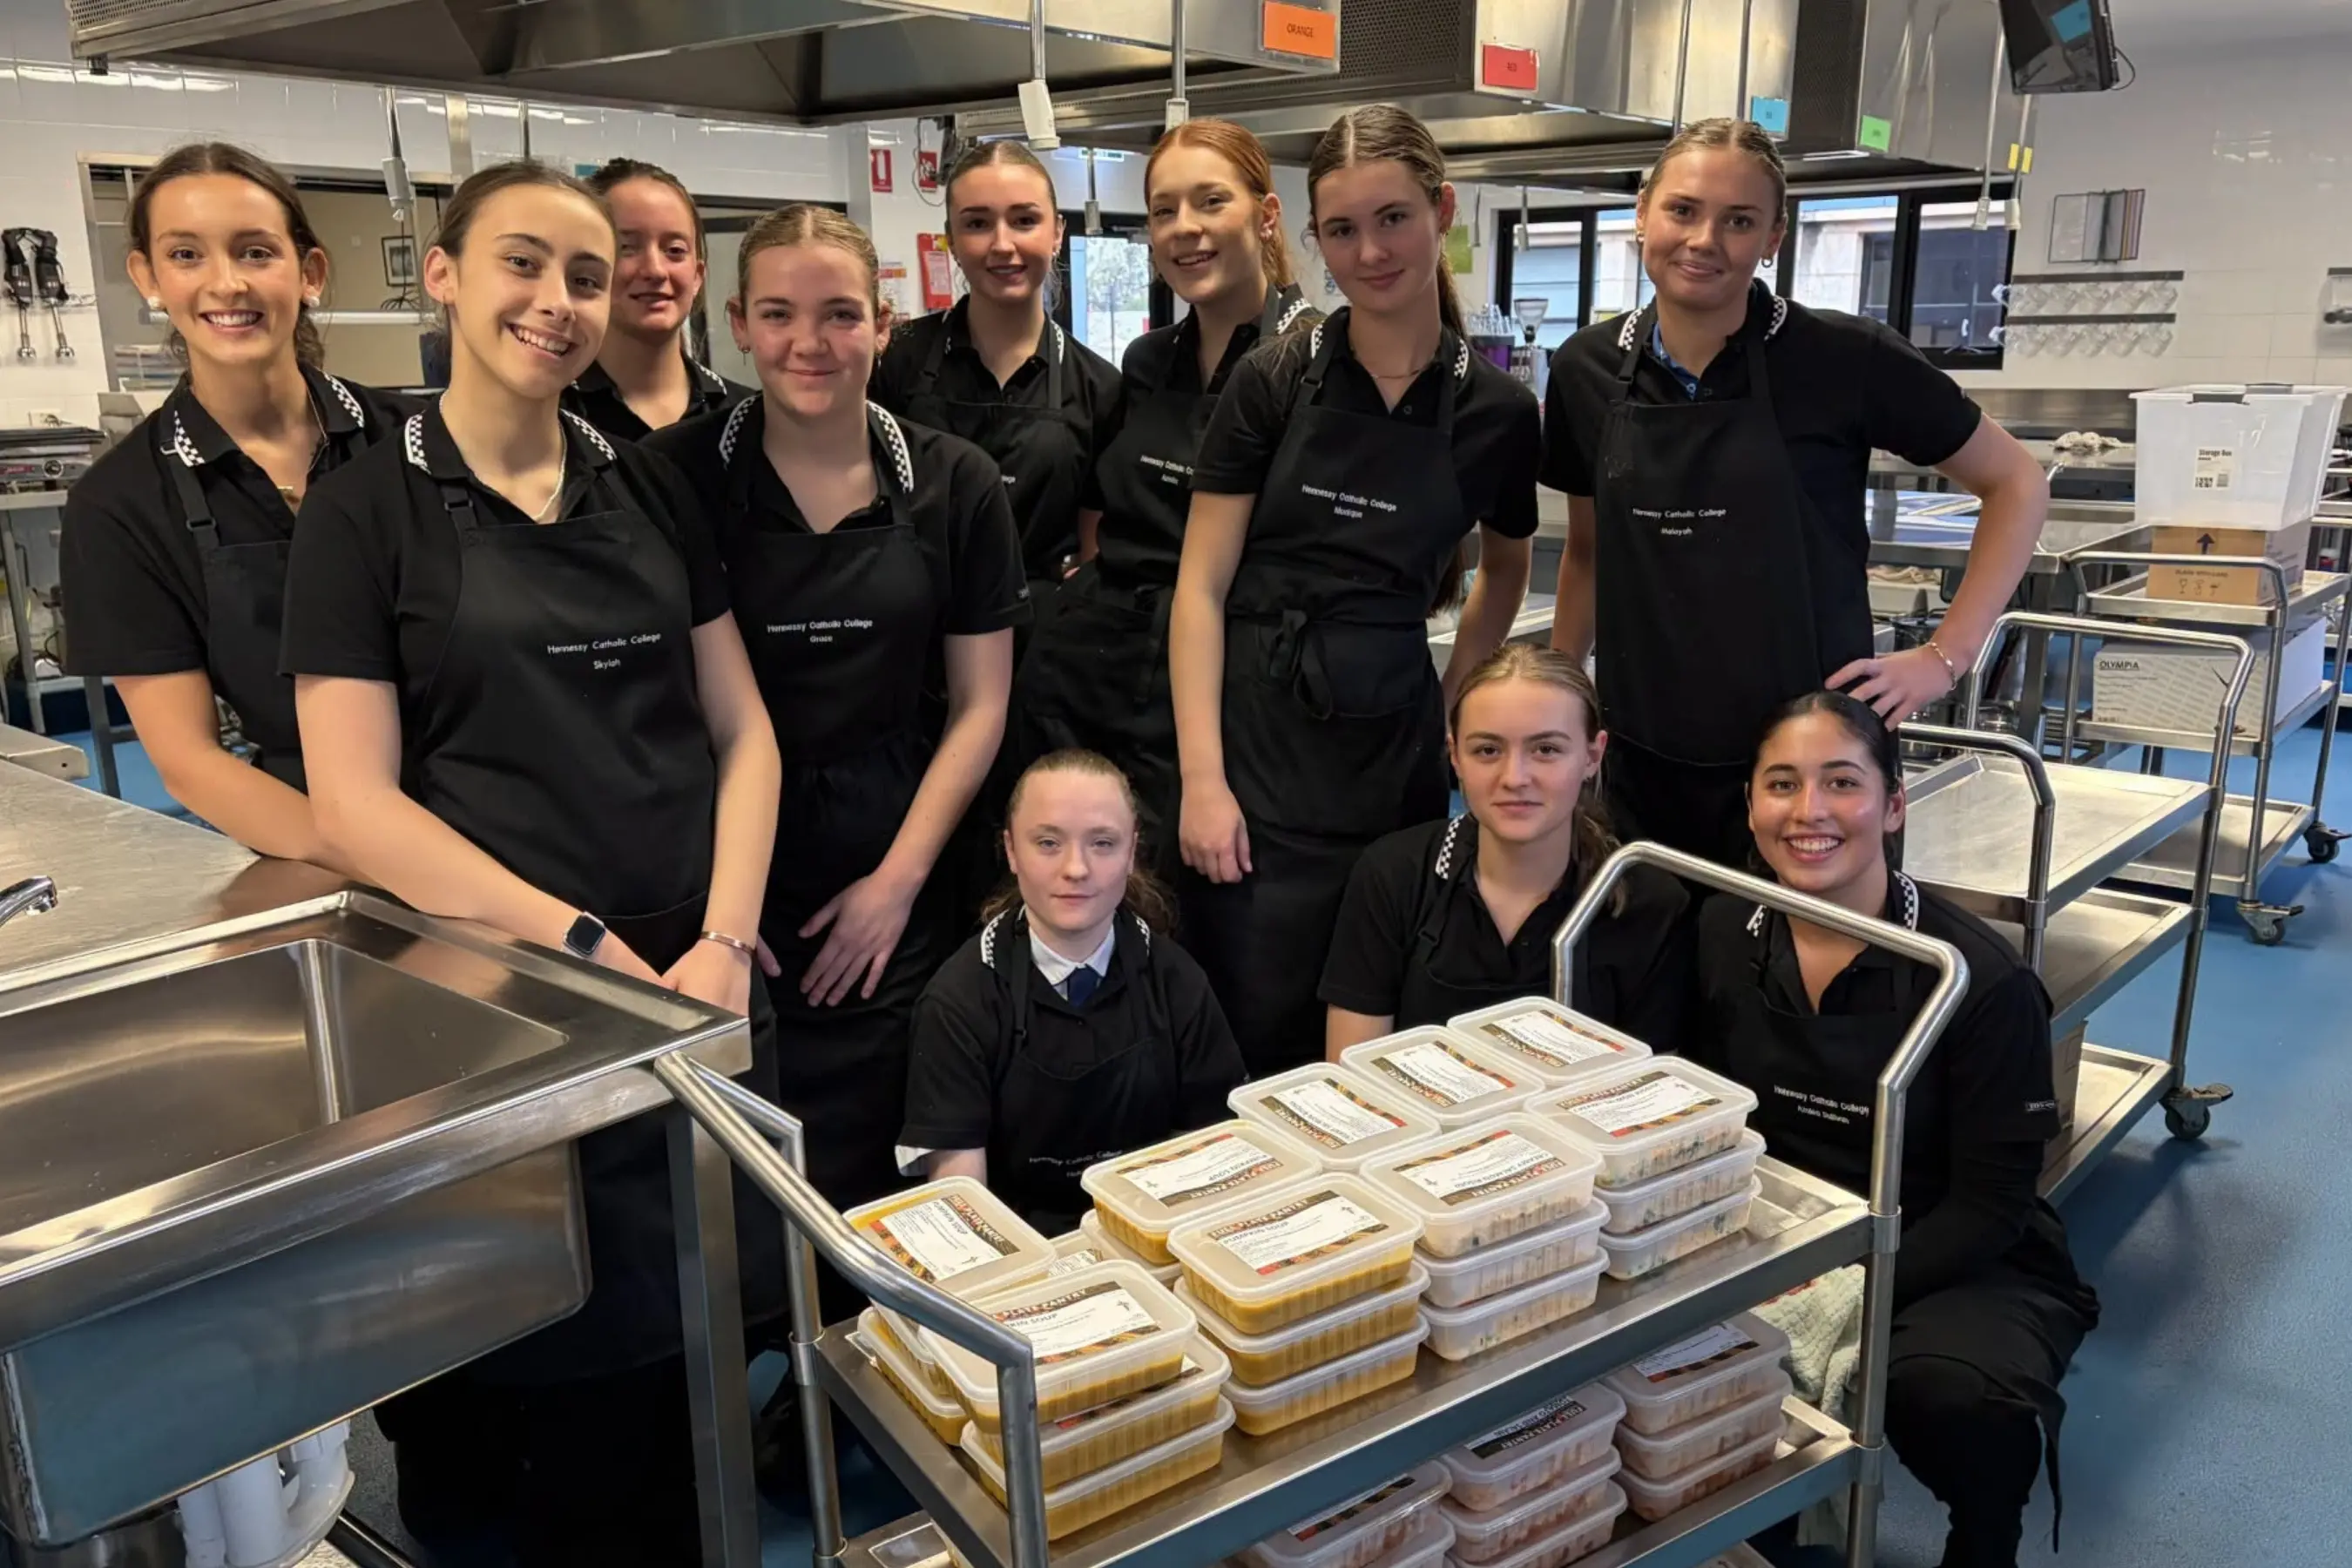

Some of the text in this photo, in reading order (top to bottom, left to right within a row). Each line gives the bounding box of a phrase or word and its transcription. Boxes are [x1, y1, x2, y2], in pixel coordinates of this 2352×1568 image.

[1287, 23, 1315, 38] ORANGE
[1302, 484, 1397, 512] Hennessy Catholic College
[767, 618, 873, 632] Hennessy Catholic College
[547, 633, 661, 654] Hennessy Catholic College
[2099, 659, 2139, 671] OLYMPIA
[1809, 1094, 1838, 1108] Catholic
[1840, 1102, 1869, 1117] College
[1208, 1168, 1231, 1181] SOUP
[1229, 1168, 1258, 1186] PLATE
[1190, 1184, 1228, 1199] PANTRY
[1472, 1180, 1510, 1197] PANTRY
[1238, 1214, 1270, 1228] PLATE
[1272, 1200, 1307, 1220] PANTRY
[1223, 1220, 1289, 1244] PUMPKIN SOUP
[1003, 1288, 1088, 1319] PLATE PANTRY
[1031, 1312, 1058, 1324] SOUP
[1501, 1407, 1584, 1450] FULL PLATE PANTRY
